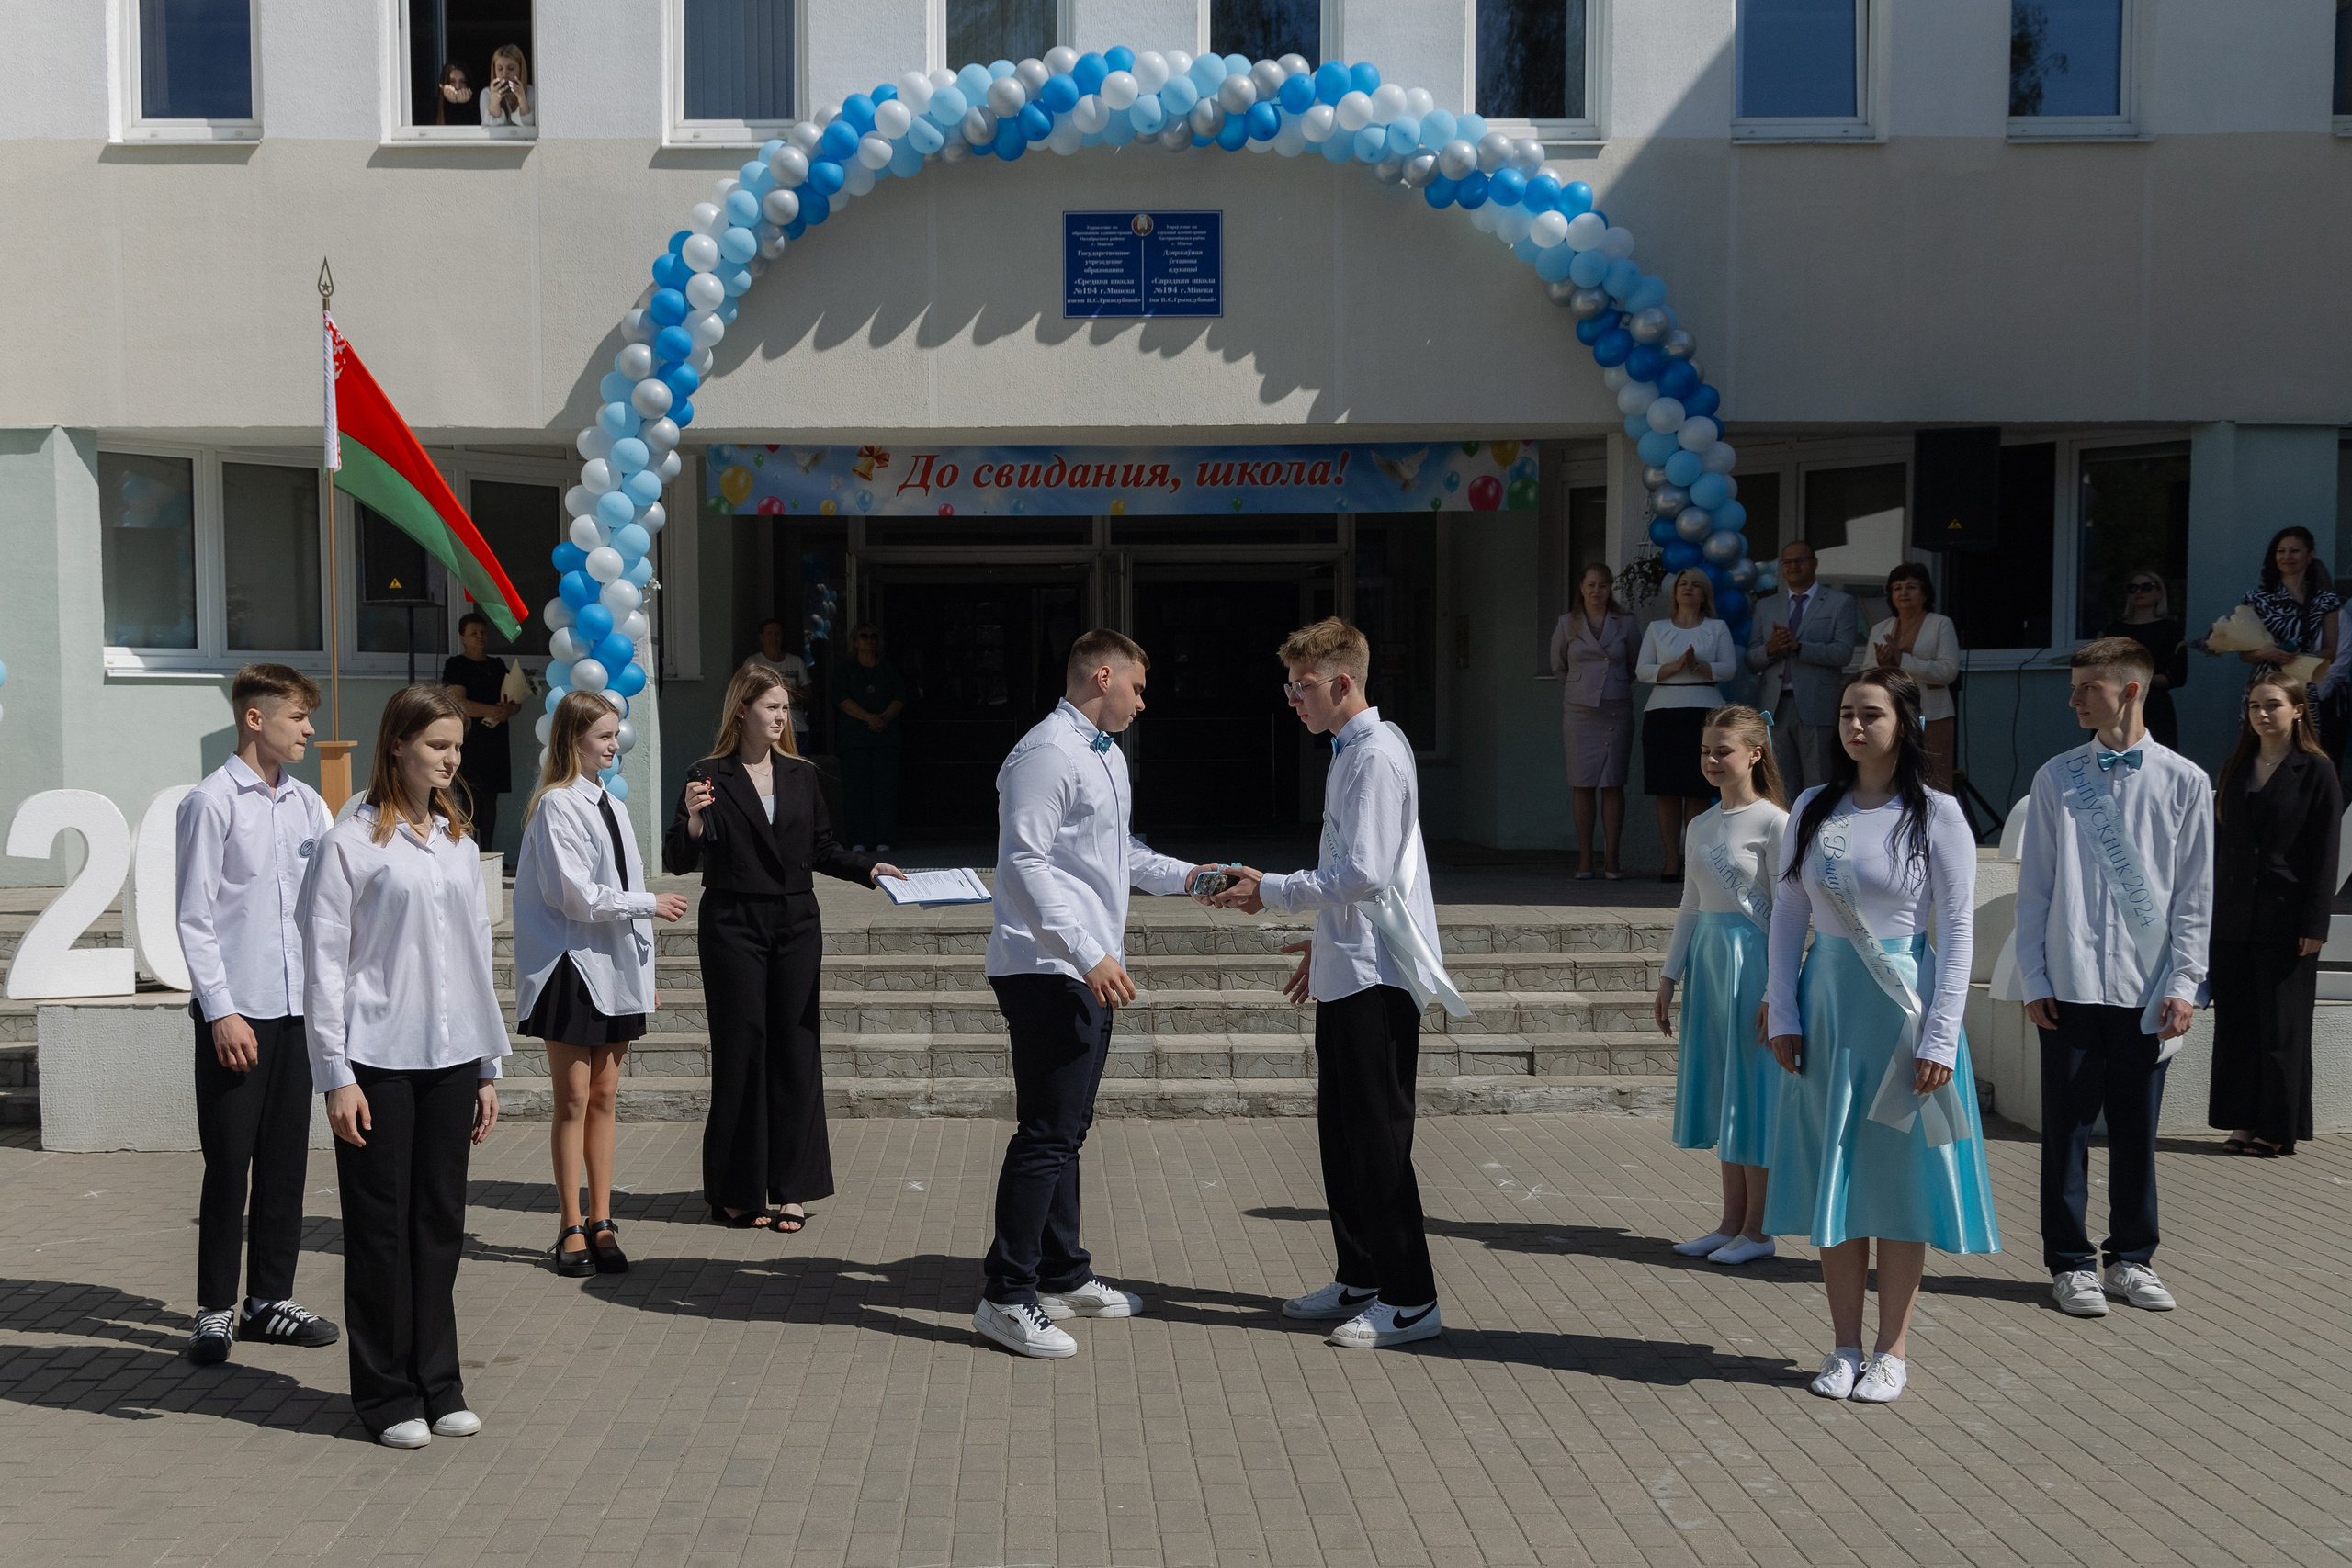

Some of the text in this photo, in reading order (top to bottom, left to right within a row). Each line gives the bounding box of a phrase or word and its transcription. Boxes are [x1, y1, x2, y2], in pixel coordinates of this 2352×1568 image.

[1072, 287, 1098, 295] №194
[1153, 286, 1178, 294] №194
[897, 451, 1350, 497] До свидания, школа!
[2066, 753, 2133, 879] Выпускник
[2122, 874, 2157, 928] 2024
[1709, 841, 1771, 920] Выпускни
